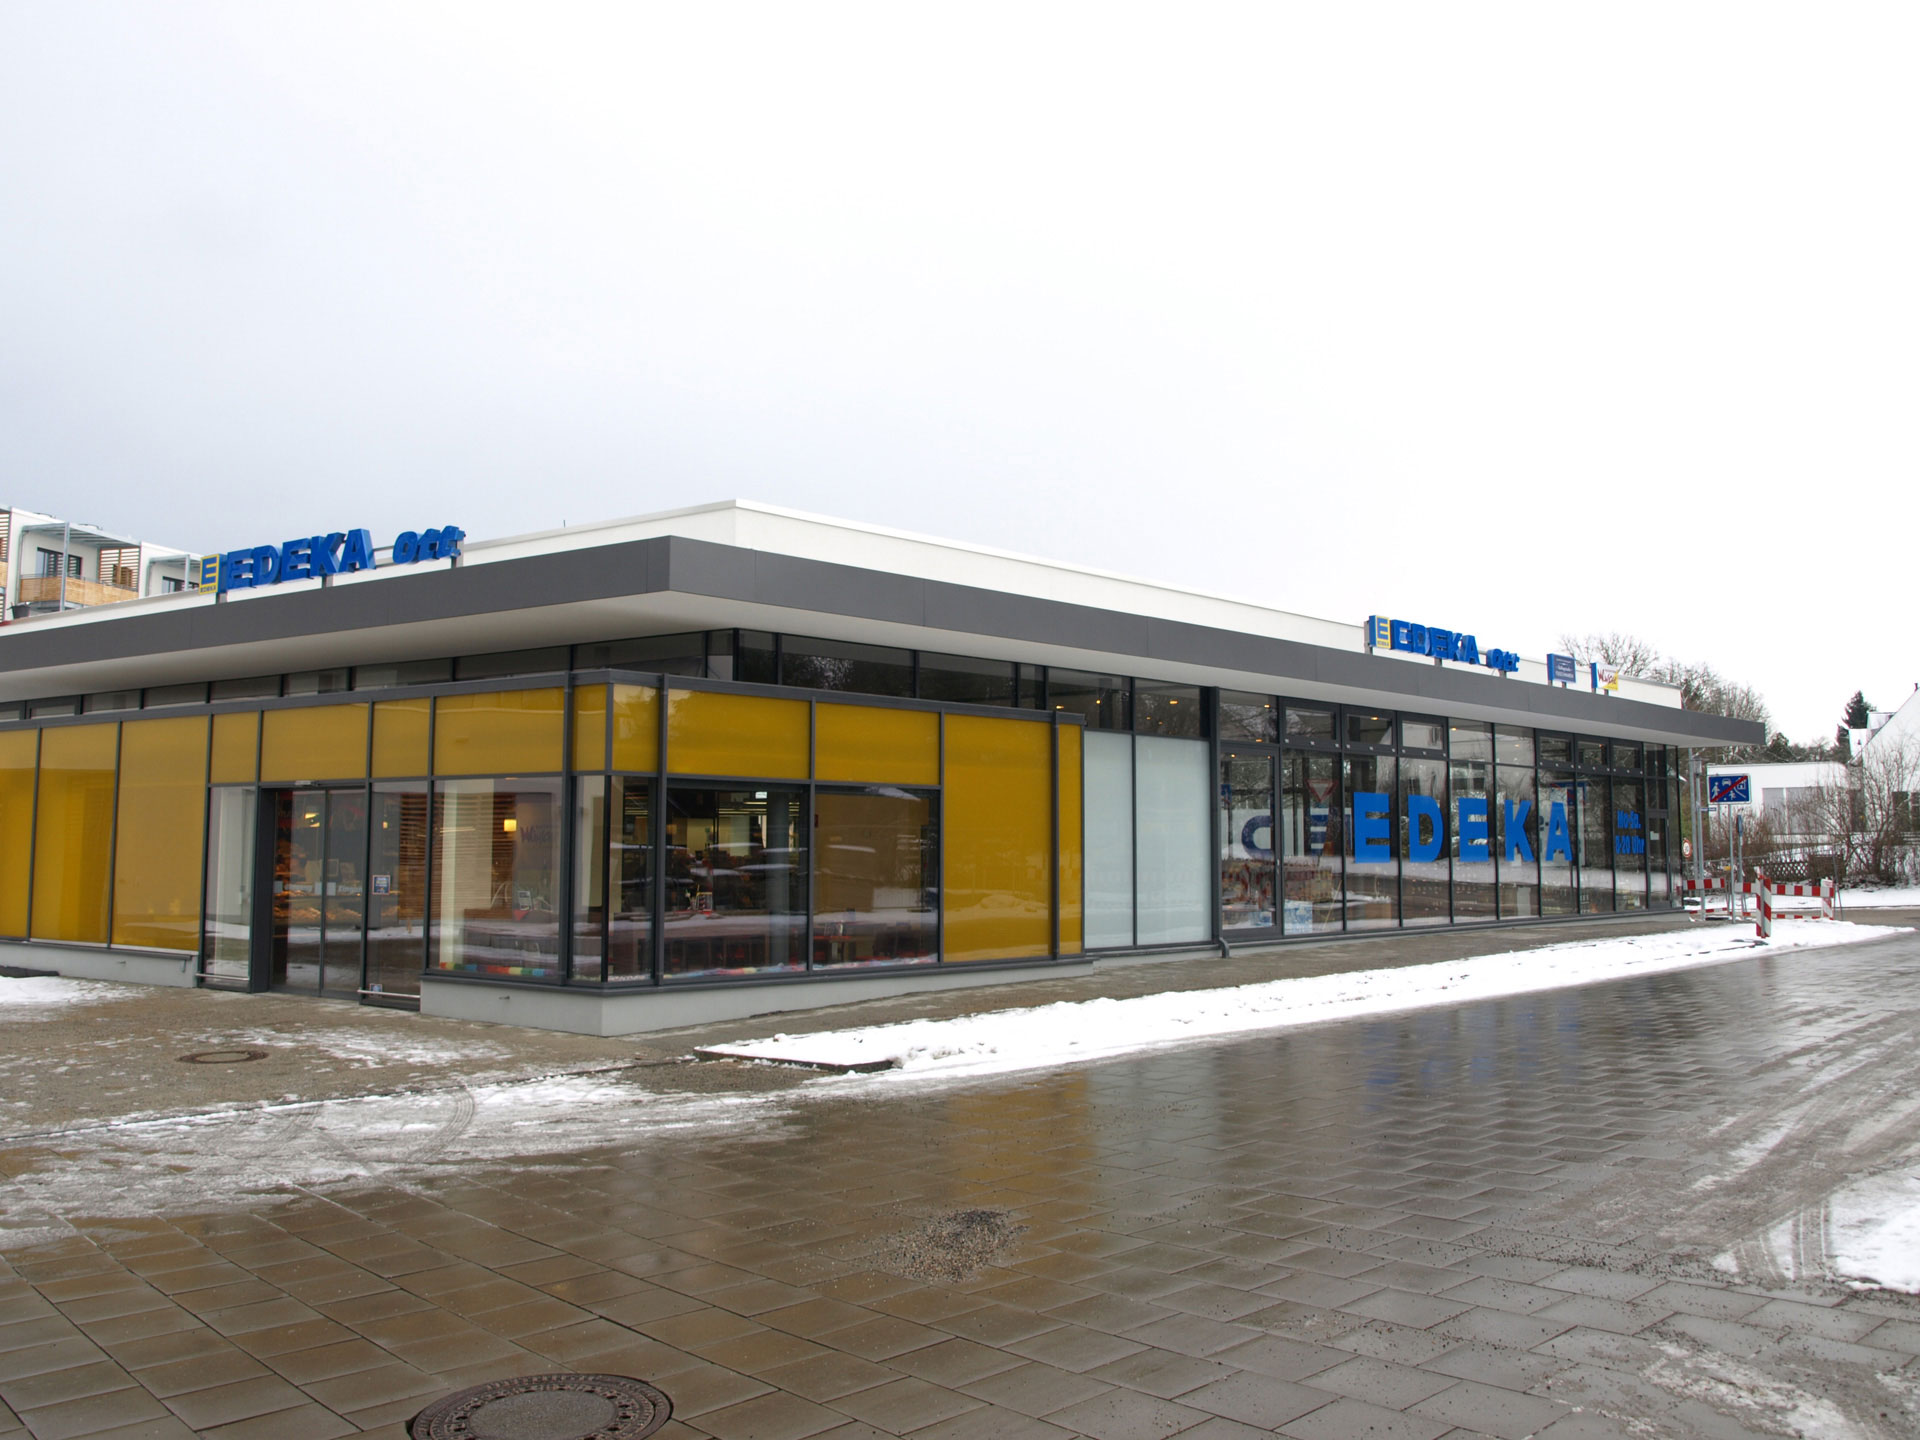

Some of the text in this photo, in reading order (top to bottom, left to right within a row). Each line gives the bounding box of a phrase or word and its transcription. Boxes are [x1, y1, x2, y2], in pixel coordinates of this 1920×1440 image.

[227, 528, 375, 589] EDEKA
[1391, 619, 1480, 665] EDEKA
[1353, 791, 1573, 863] EDEKA
[1616, 835, 1645, 855] 8-20 Uhr
